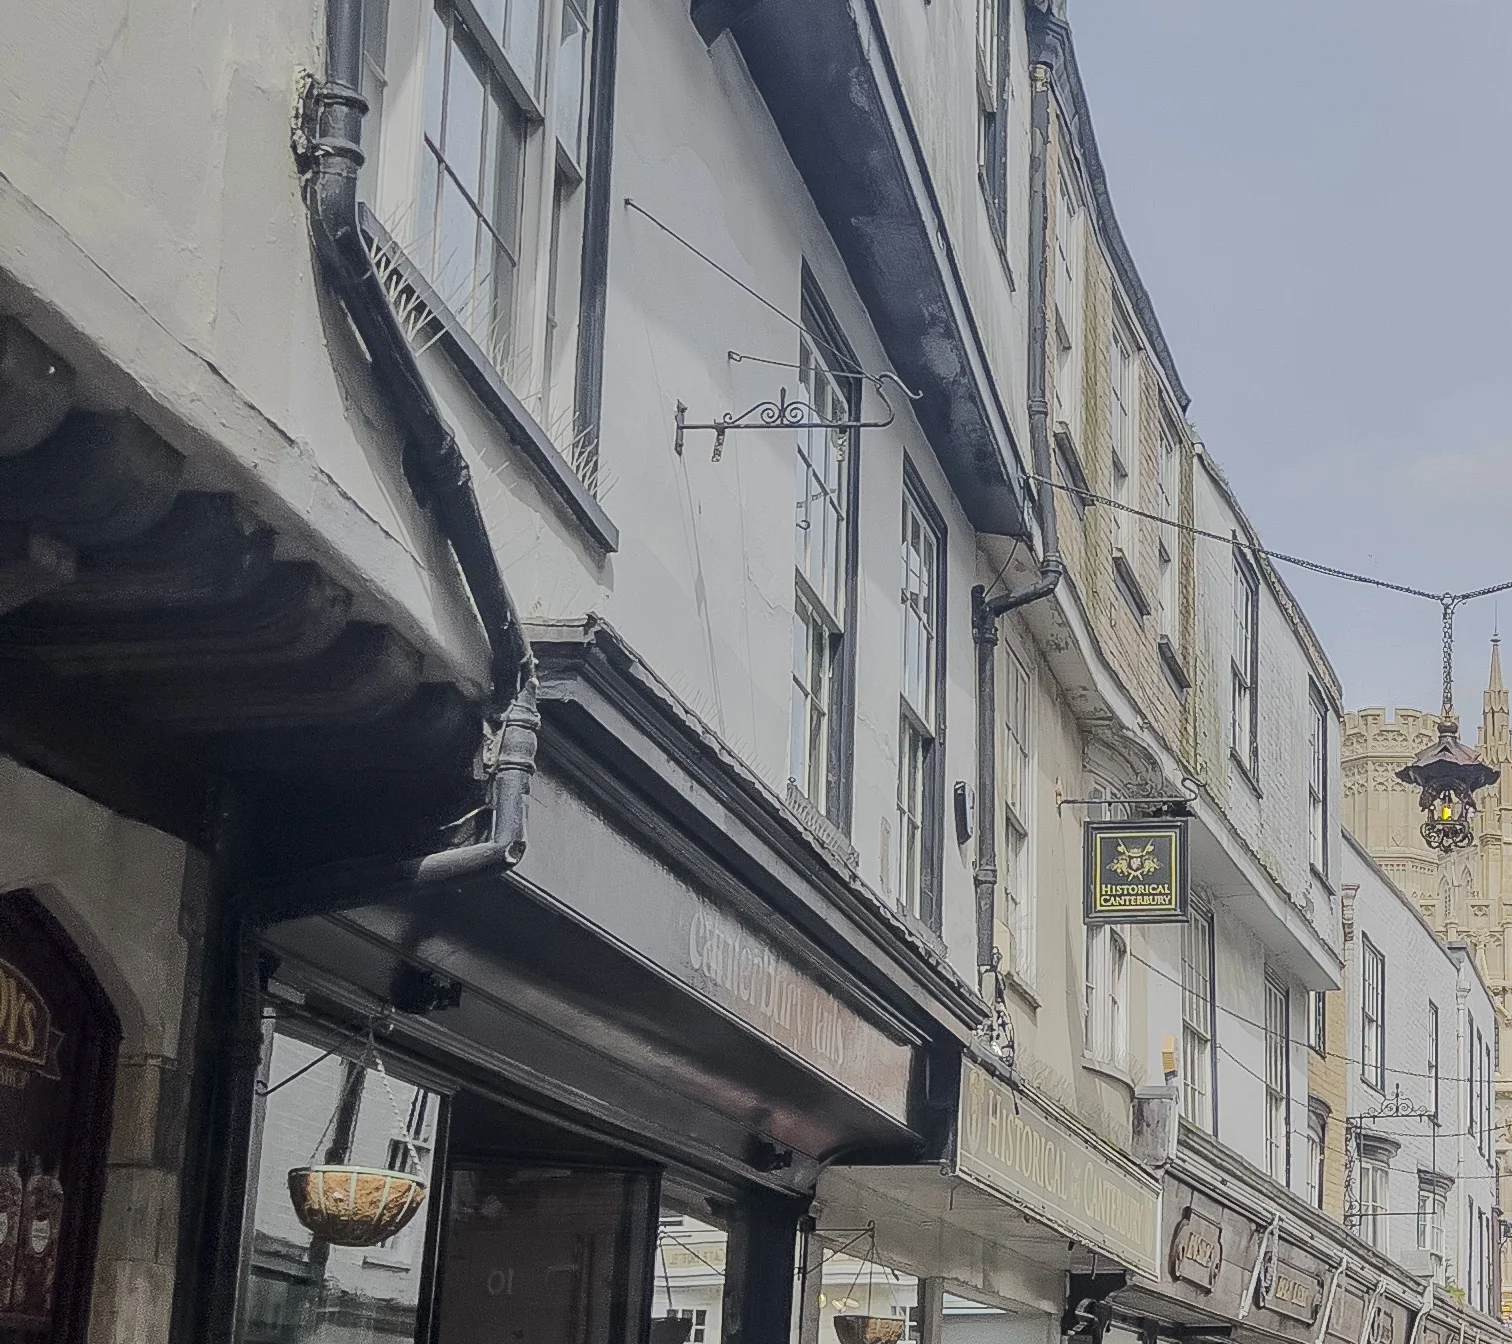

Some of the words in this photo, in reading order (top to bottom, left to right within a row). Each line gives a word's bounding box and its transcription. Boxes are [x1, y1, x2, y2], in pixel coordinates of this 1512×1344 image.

[1101, 883, 1170, 895] HISTORICAL
[1101, 895, 1171, 906] CANTERBURY
[987, 1089, 1068, 1201] HISTORICAL
[1083, 1161, 1144, 1246] CANTERBURY
